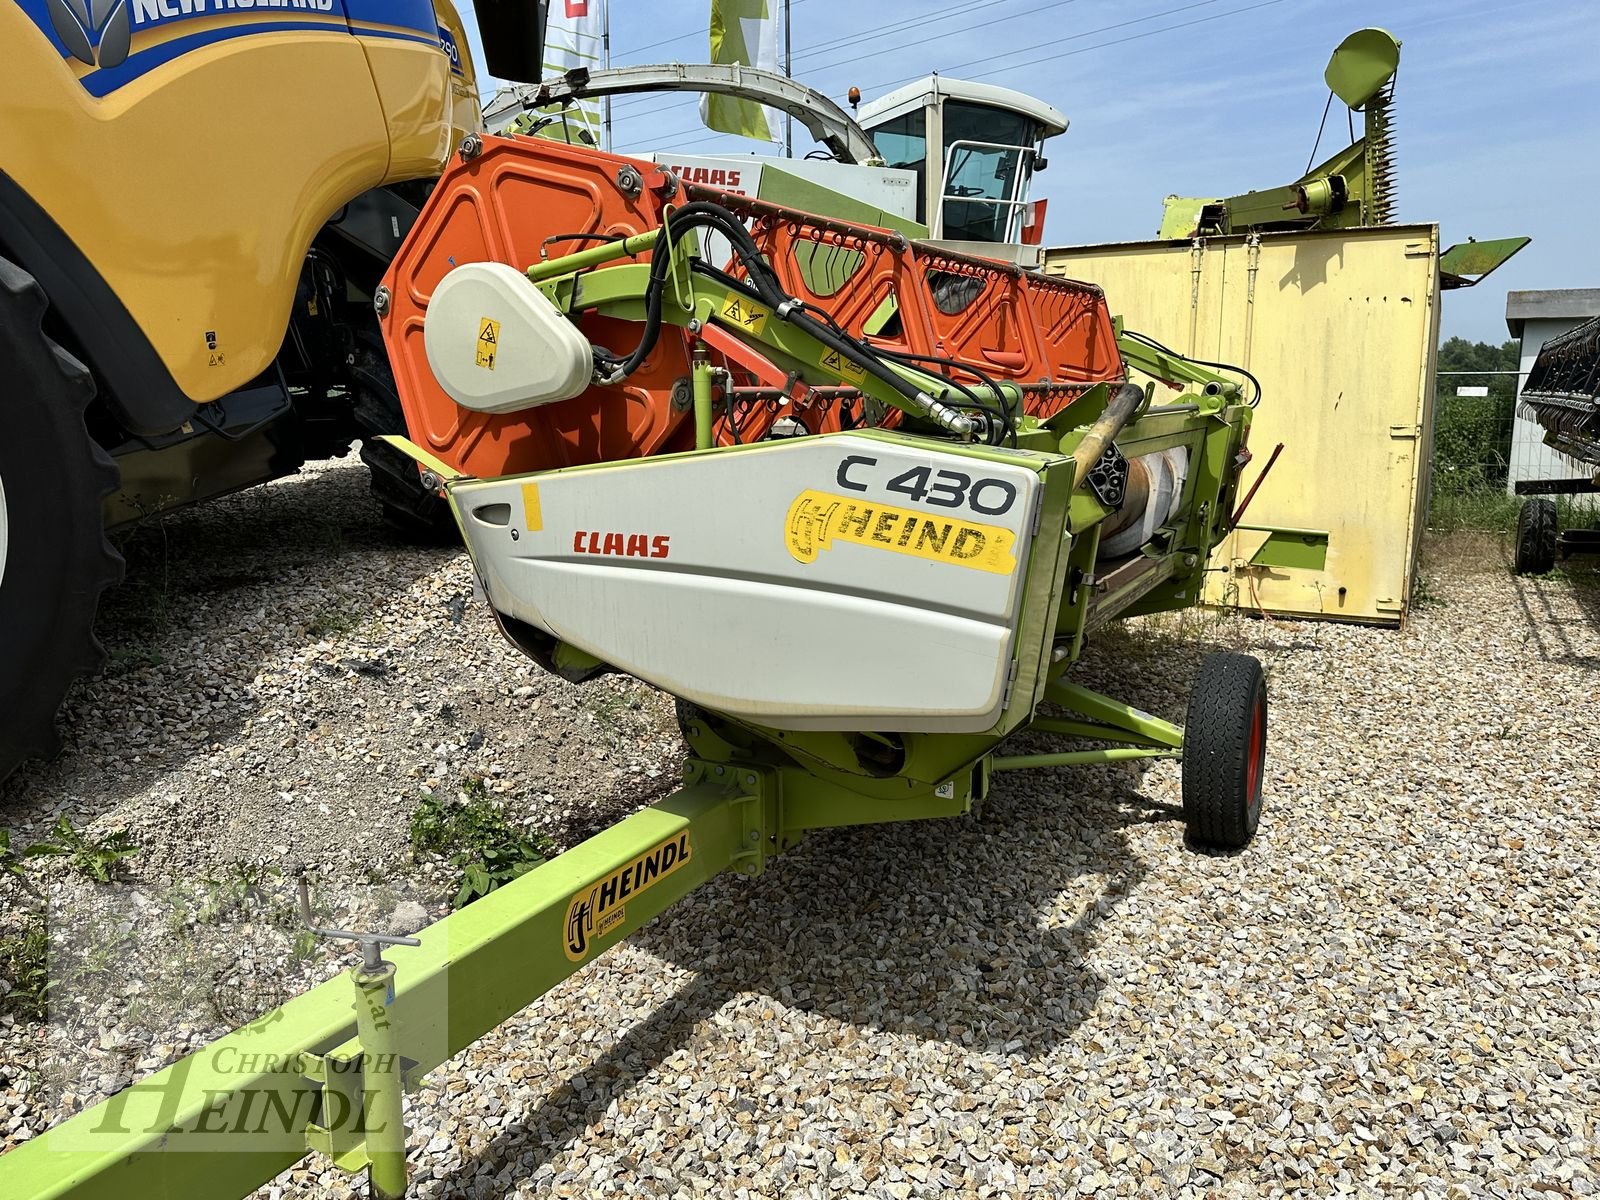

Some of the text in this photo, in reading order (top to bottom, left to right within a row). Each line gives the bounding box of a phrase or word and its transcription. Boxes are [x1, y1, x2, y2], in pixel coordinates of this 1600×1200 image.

[837, 456, 1017, 517] C 430
[573, 531, 670, 559] CLAAS
[838, 505, 1004, 567] HEIND
[598, 835, 688, 913] HEINDL
